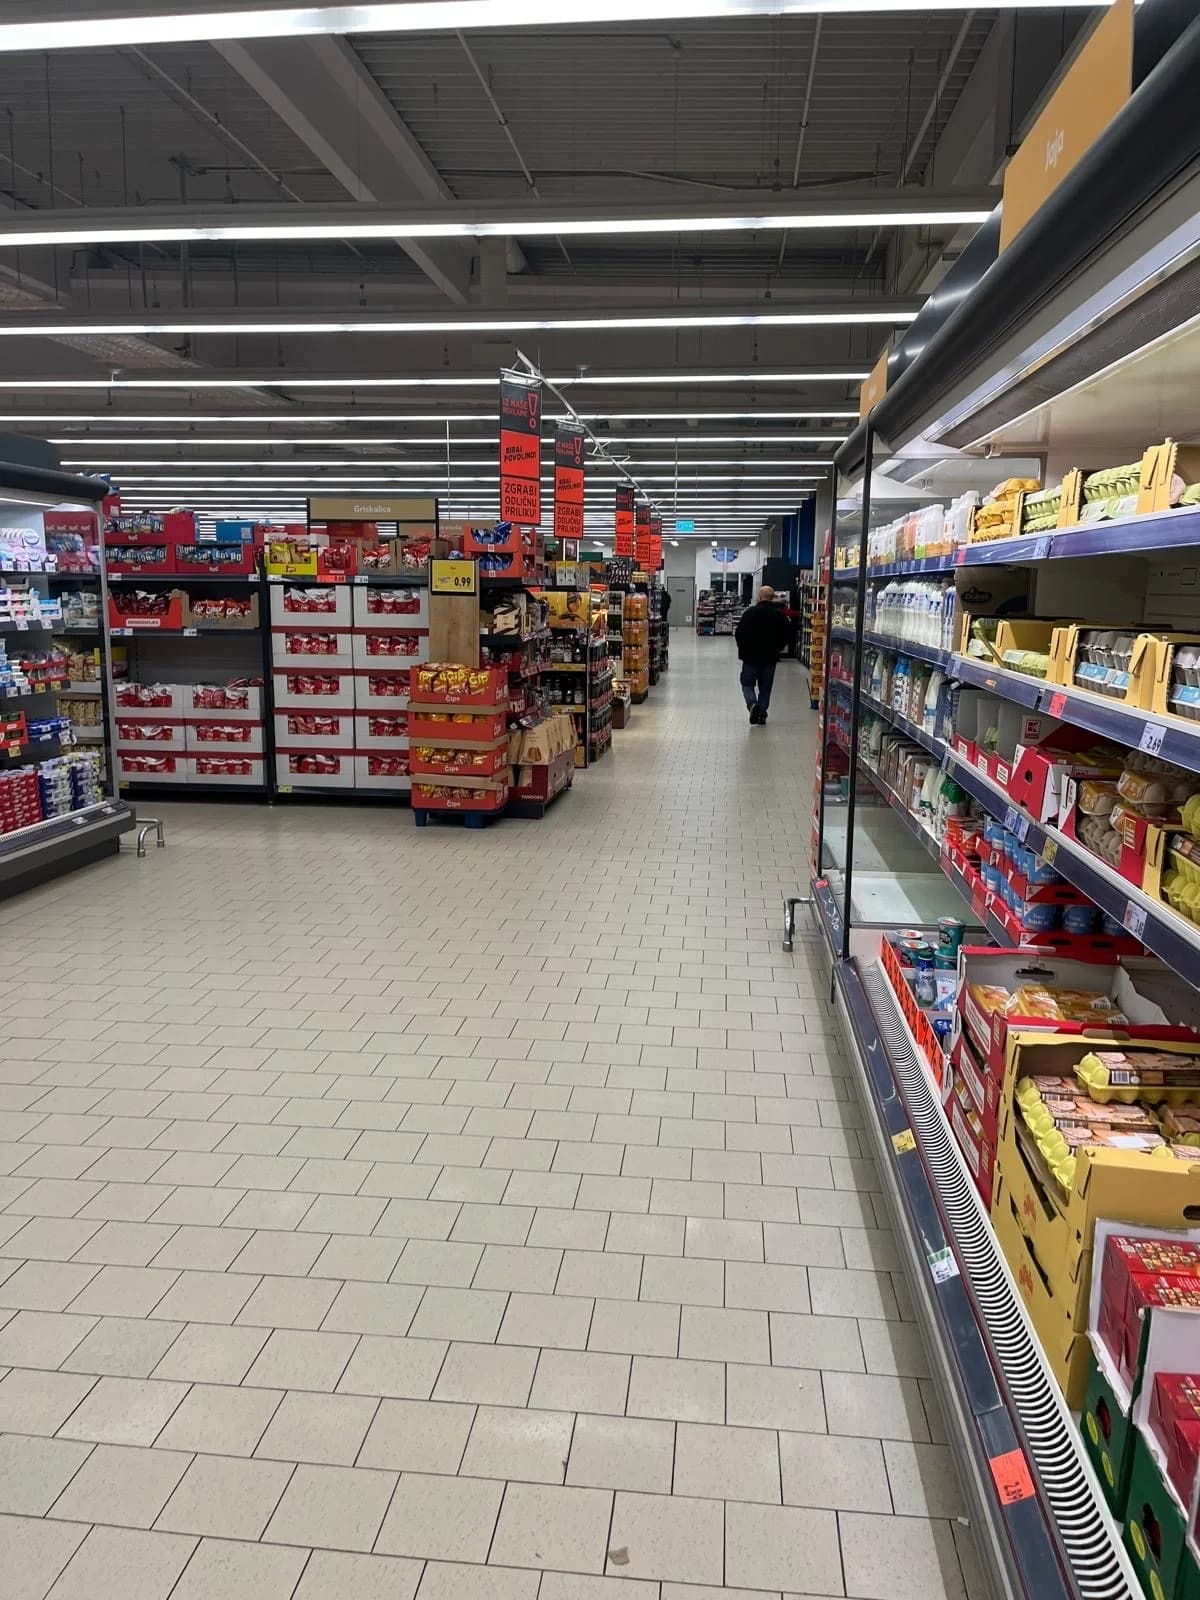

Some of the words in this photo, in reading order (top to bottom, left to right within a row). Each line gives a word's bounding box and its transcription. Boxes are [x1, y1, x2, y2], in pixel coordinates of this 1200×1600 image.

[505, 446, 522, 455] BIRAJ
[504, 483, 537, 496] ZGRABI
[504, 496, 537, 507] ODLIČNU
[353, 504, 391, 513] Grickalice
[505, 507, 537, 518] PRILIKU!
[454, 576, 471, 587] 0.99
[445, 694, 460, 702] Čips
[444, 764, 459, 772] Čips
[446, 800, 461, 808] Čips
